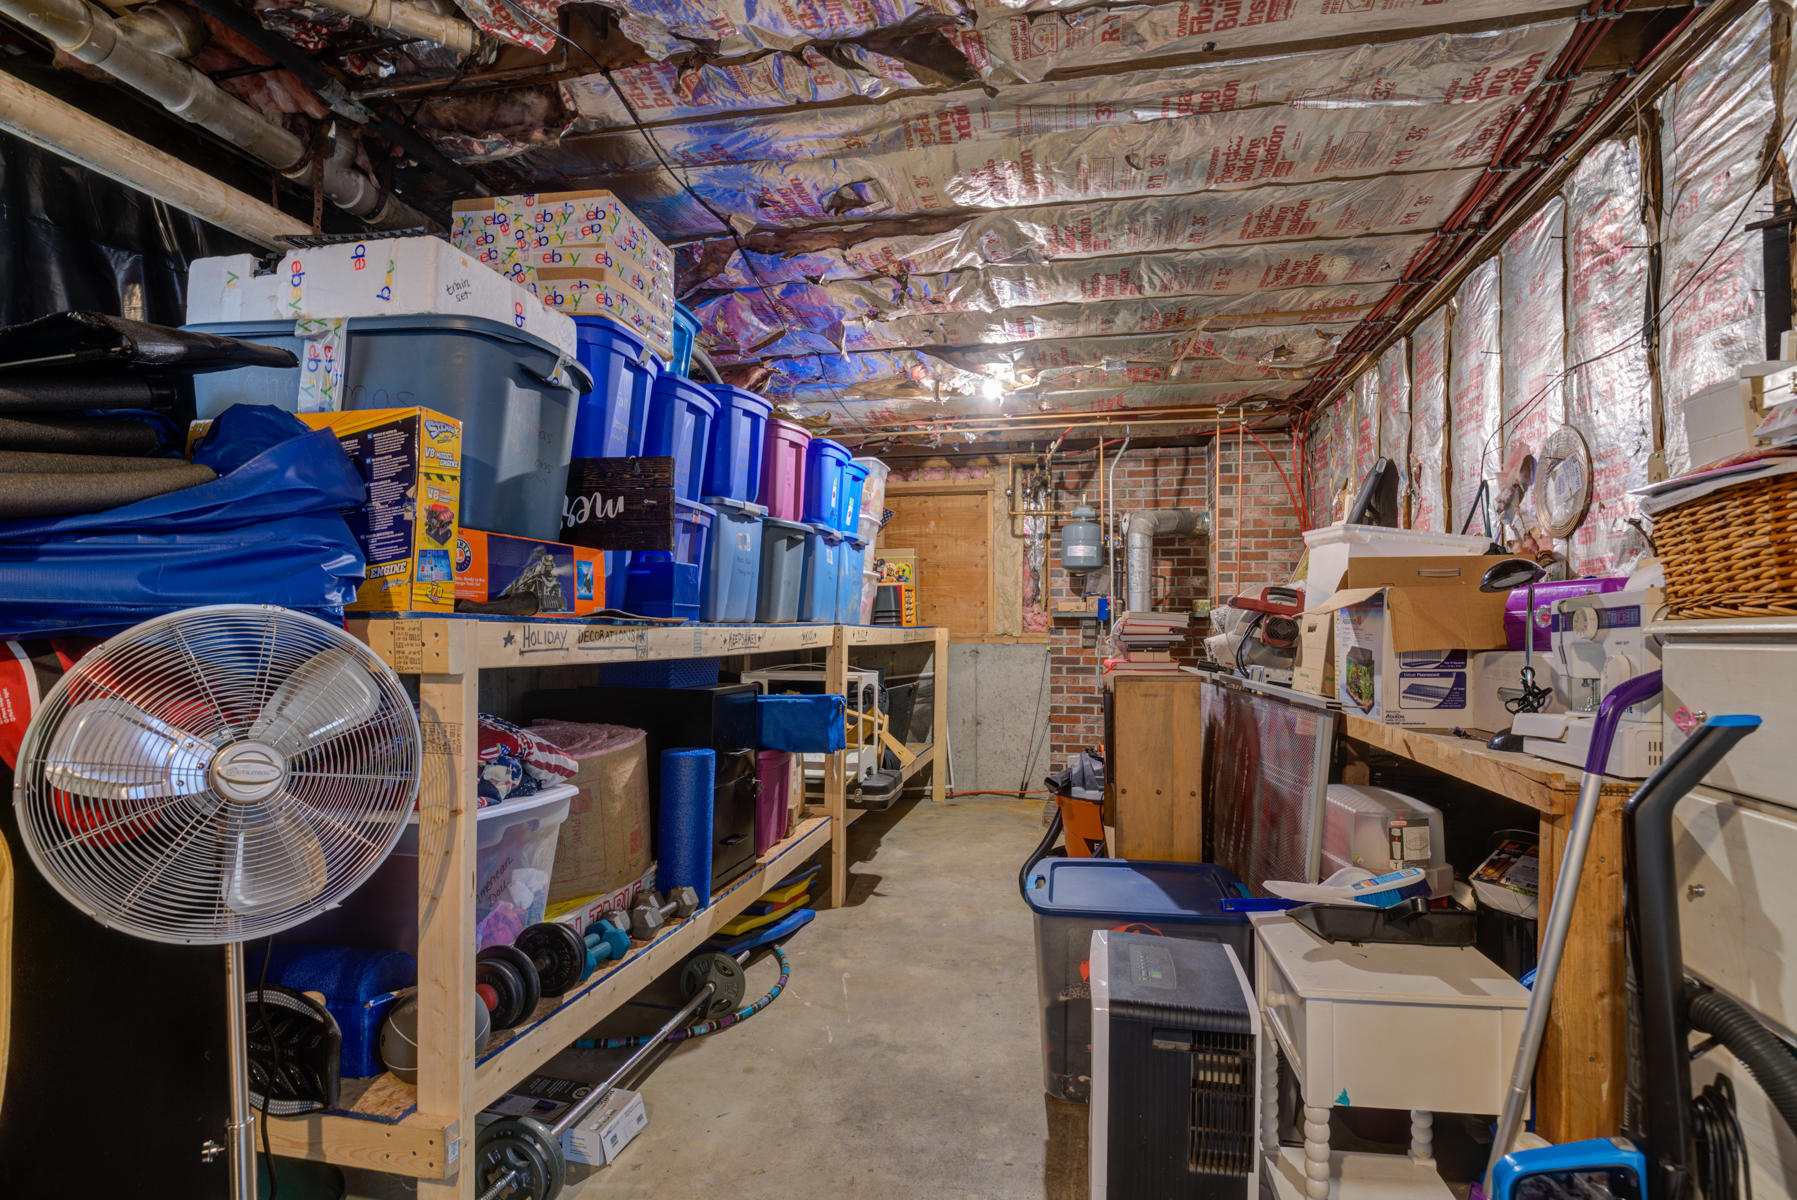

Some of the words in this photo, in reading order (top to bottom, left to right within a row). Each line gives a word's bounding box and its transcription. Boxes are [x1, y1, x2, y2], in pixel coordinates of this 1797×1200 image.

[1461, 66, 1491, 102] glas
[1509, 51, 1547, 96] ation
[1232, 137, 1268, 183] Building
[1252, 125, 1287, 180] Insulation
[542, 250, 580, 266] ebay
[595, 251, 624, 277] ebay
[446, 279, 471, 295] train
[456, 290, 471, 302] set
[544, 290, 581, 311] ebay
[369, 562, 407, 579] ENGINE
[522, 624, 568, 649] HOLIDAY
[577, 629, 636, 645] DECORATIONS
[476, 856, 514, 904] merican
